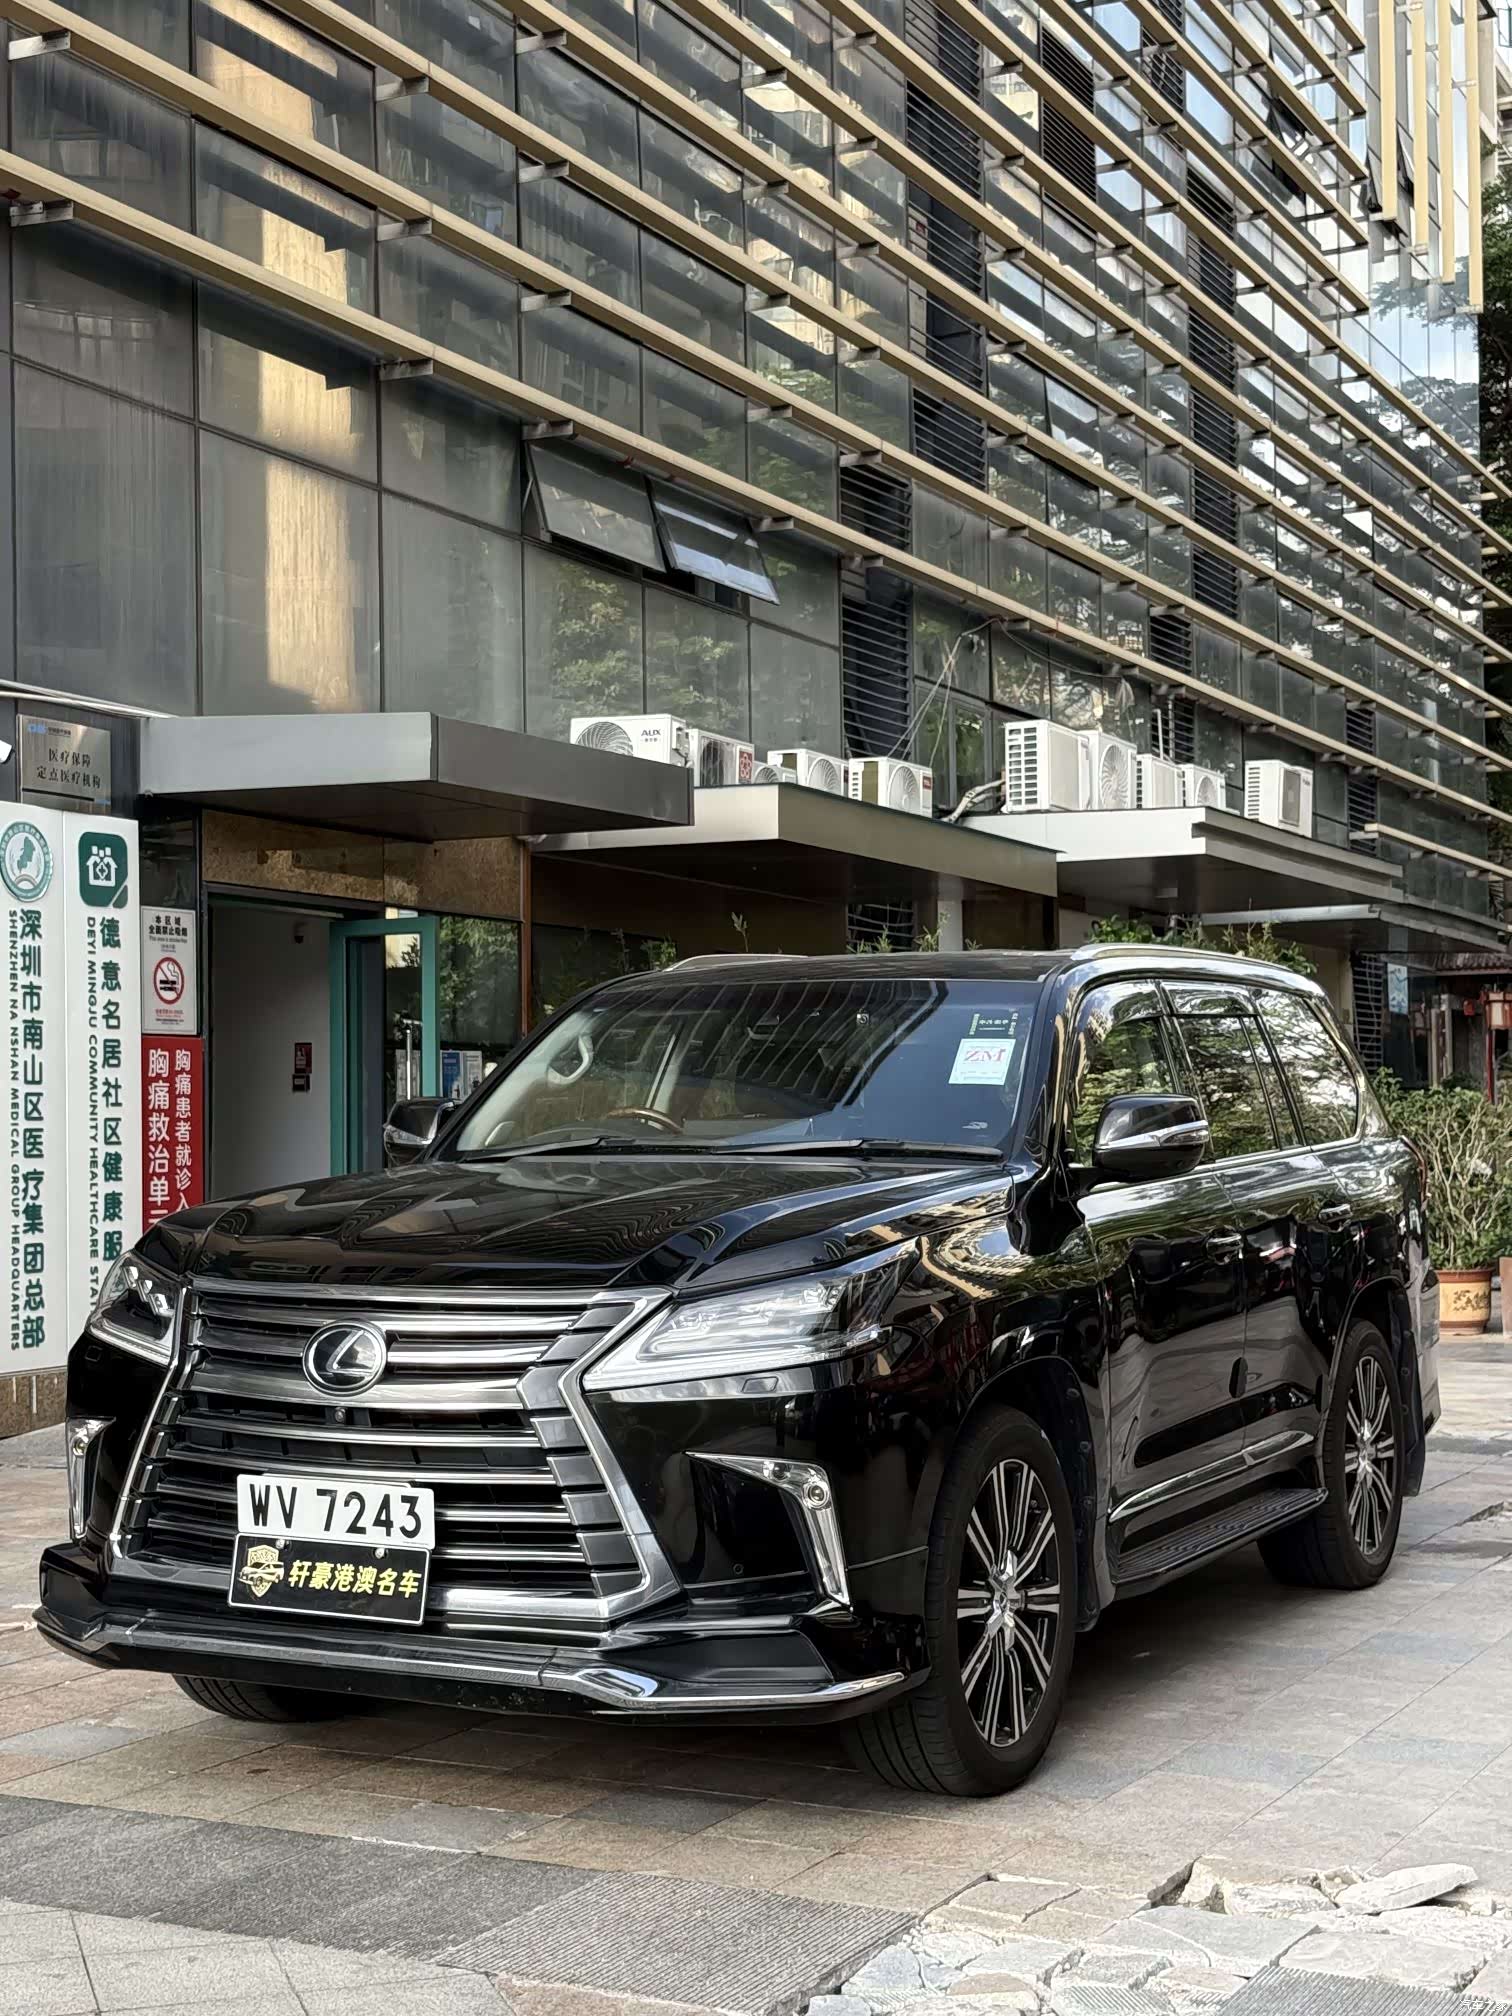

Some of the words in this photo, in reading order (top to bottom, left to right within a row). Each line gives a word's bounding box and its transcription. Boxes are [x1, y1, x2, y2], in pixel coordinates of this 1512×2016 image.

[48, 748, 92, 768] 医疗保障
[641, 729, 661, 737] AUX
[36, 765, 101, 789] 定点医疗机构
[9, 909, 19, 993] SHENZHEN
[87, 916, 97, 955] DEYI
[87, 959, 98, 1028] MINGJU
[10, 1087, 20, 1158] MEDICAL
[88, 1034, 99, 1143] COMMUNITY
[99, 916, 123, 1262] 德意名居社区健康服
[19, 908, 46, 1349] 深圳市南山区医疗集团总部
[174, 1048, 192, 1212] 胸痛患者就诊入
[10, 1163, 21, 1218] GROUP
[89, 1147, 99, 1259] HEALTHCARE
[10, 1224, 21, 1351] HEADQUARTERS
[249, 1483, 298, 1529] WV
[316, 1488, 422, 1539] 7243
[288, 1559, 422, 1598] 轩豪港澳名车
